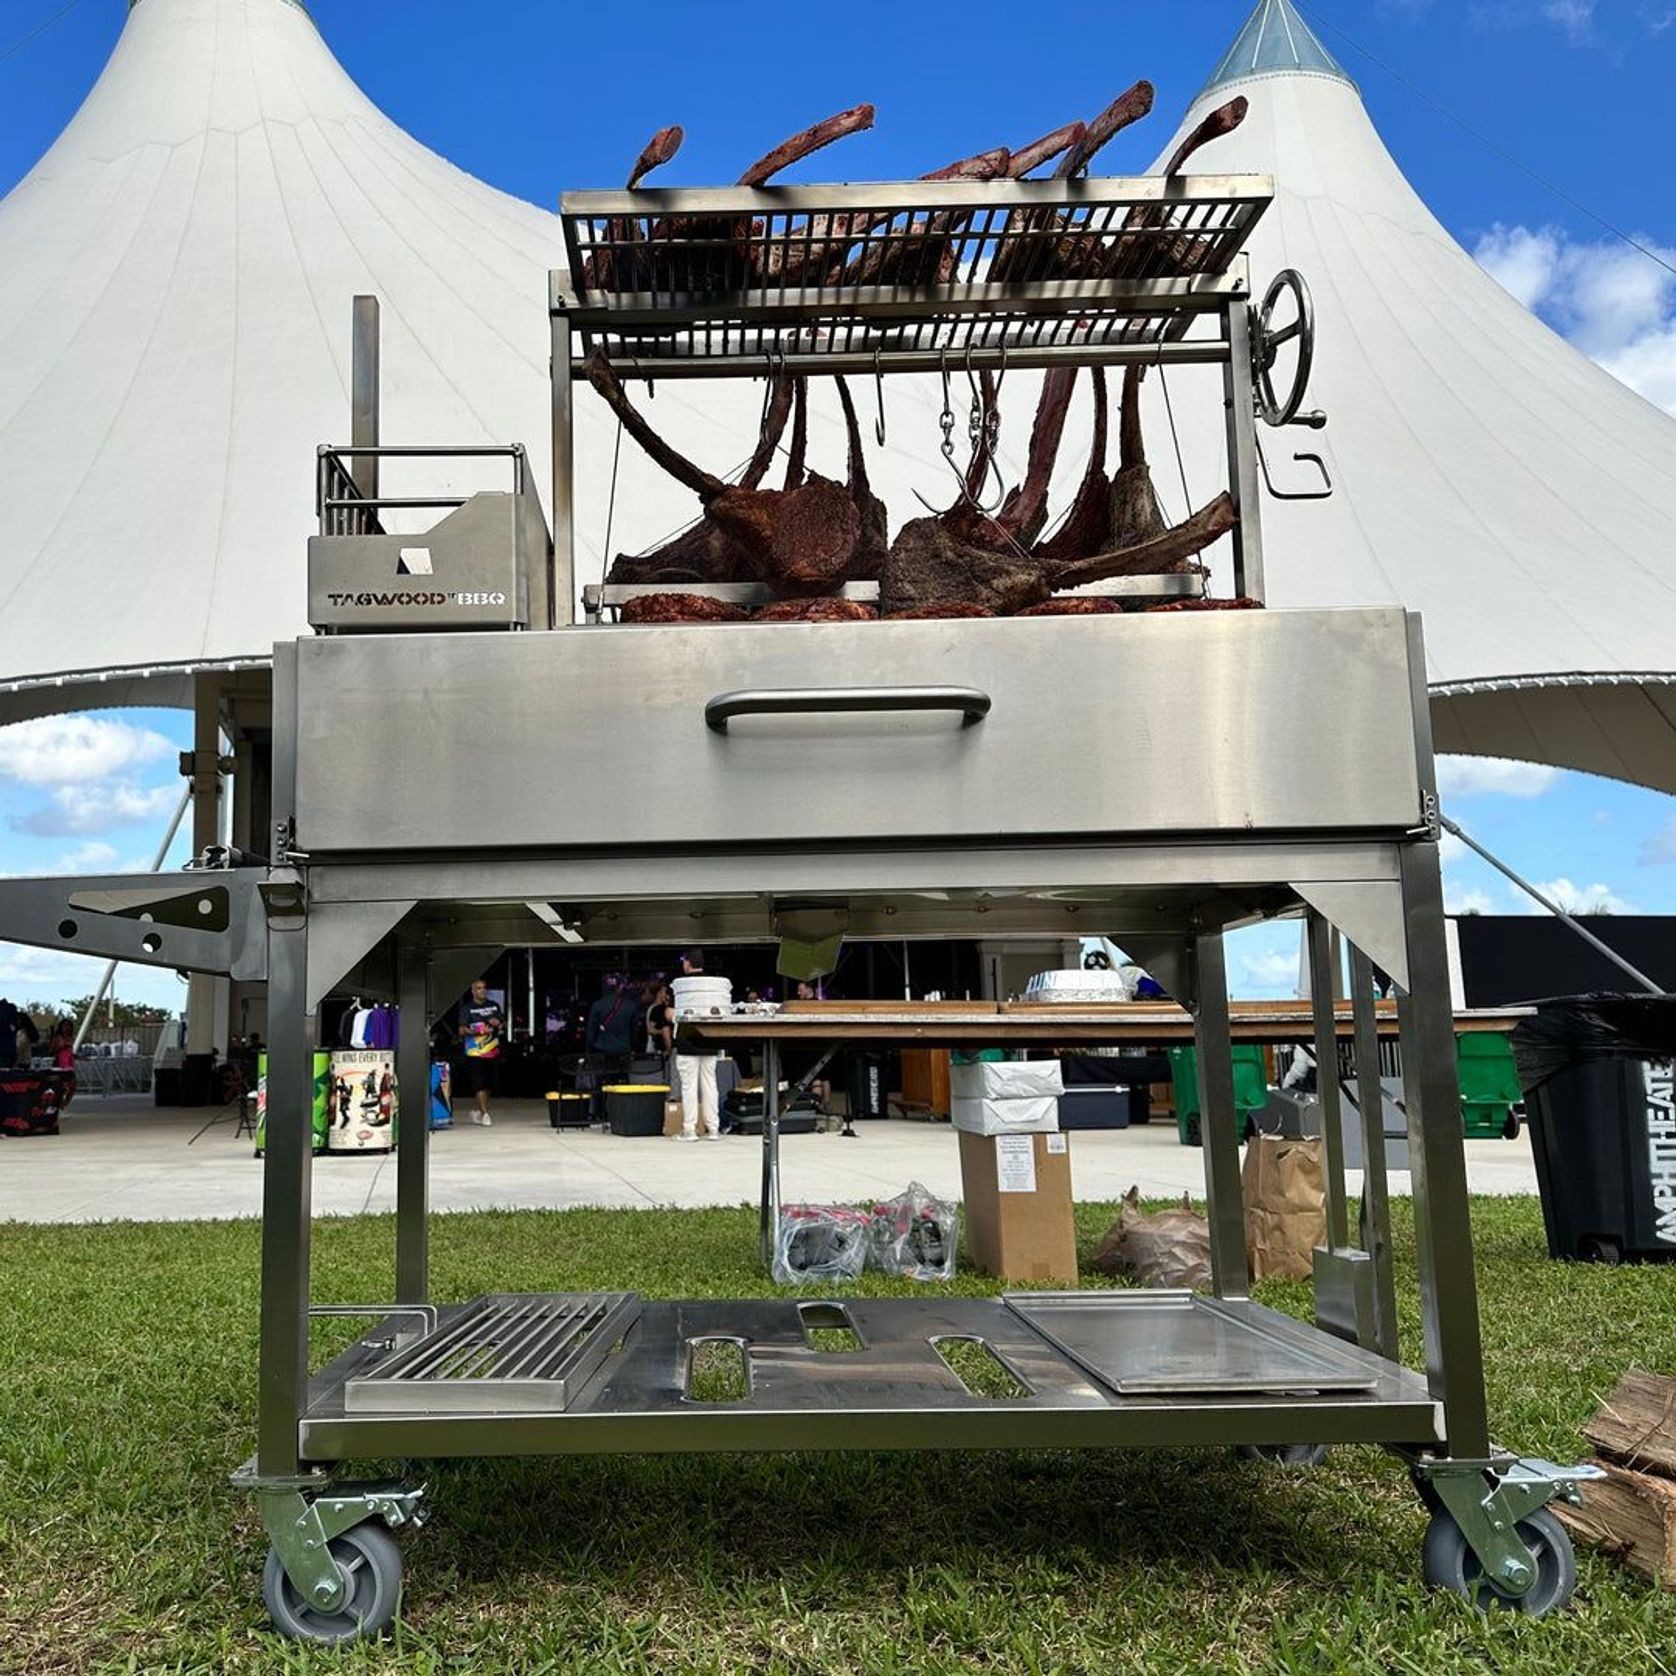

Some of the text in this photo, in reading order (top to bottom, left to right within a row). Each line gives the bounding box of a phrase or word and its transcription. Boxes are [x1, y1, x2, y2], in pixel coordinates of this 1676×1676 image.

[327, 592, 446, 606] TAGWOOD
[457, 591, 506, 605] BBQ
[1641, 1059, 1676, 1243] AMPHITHEATE
